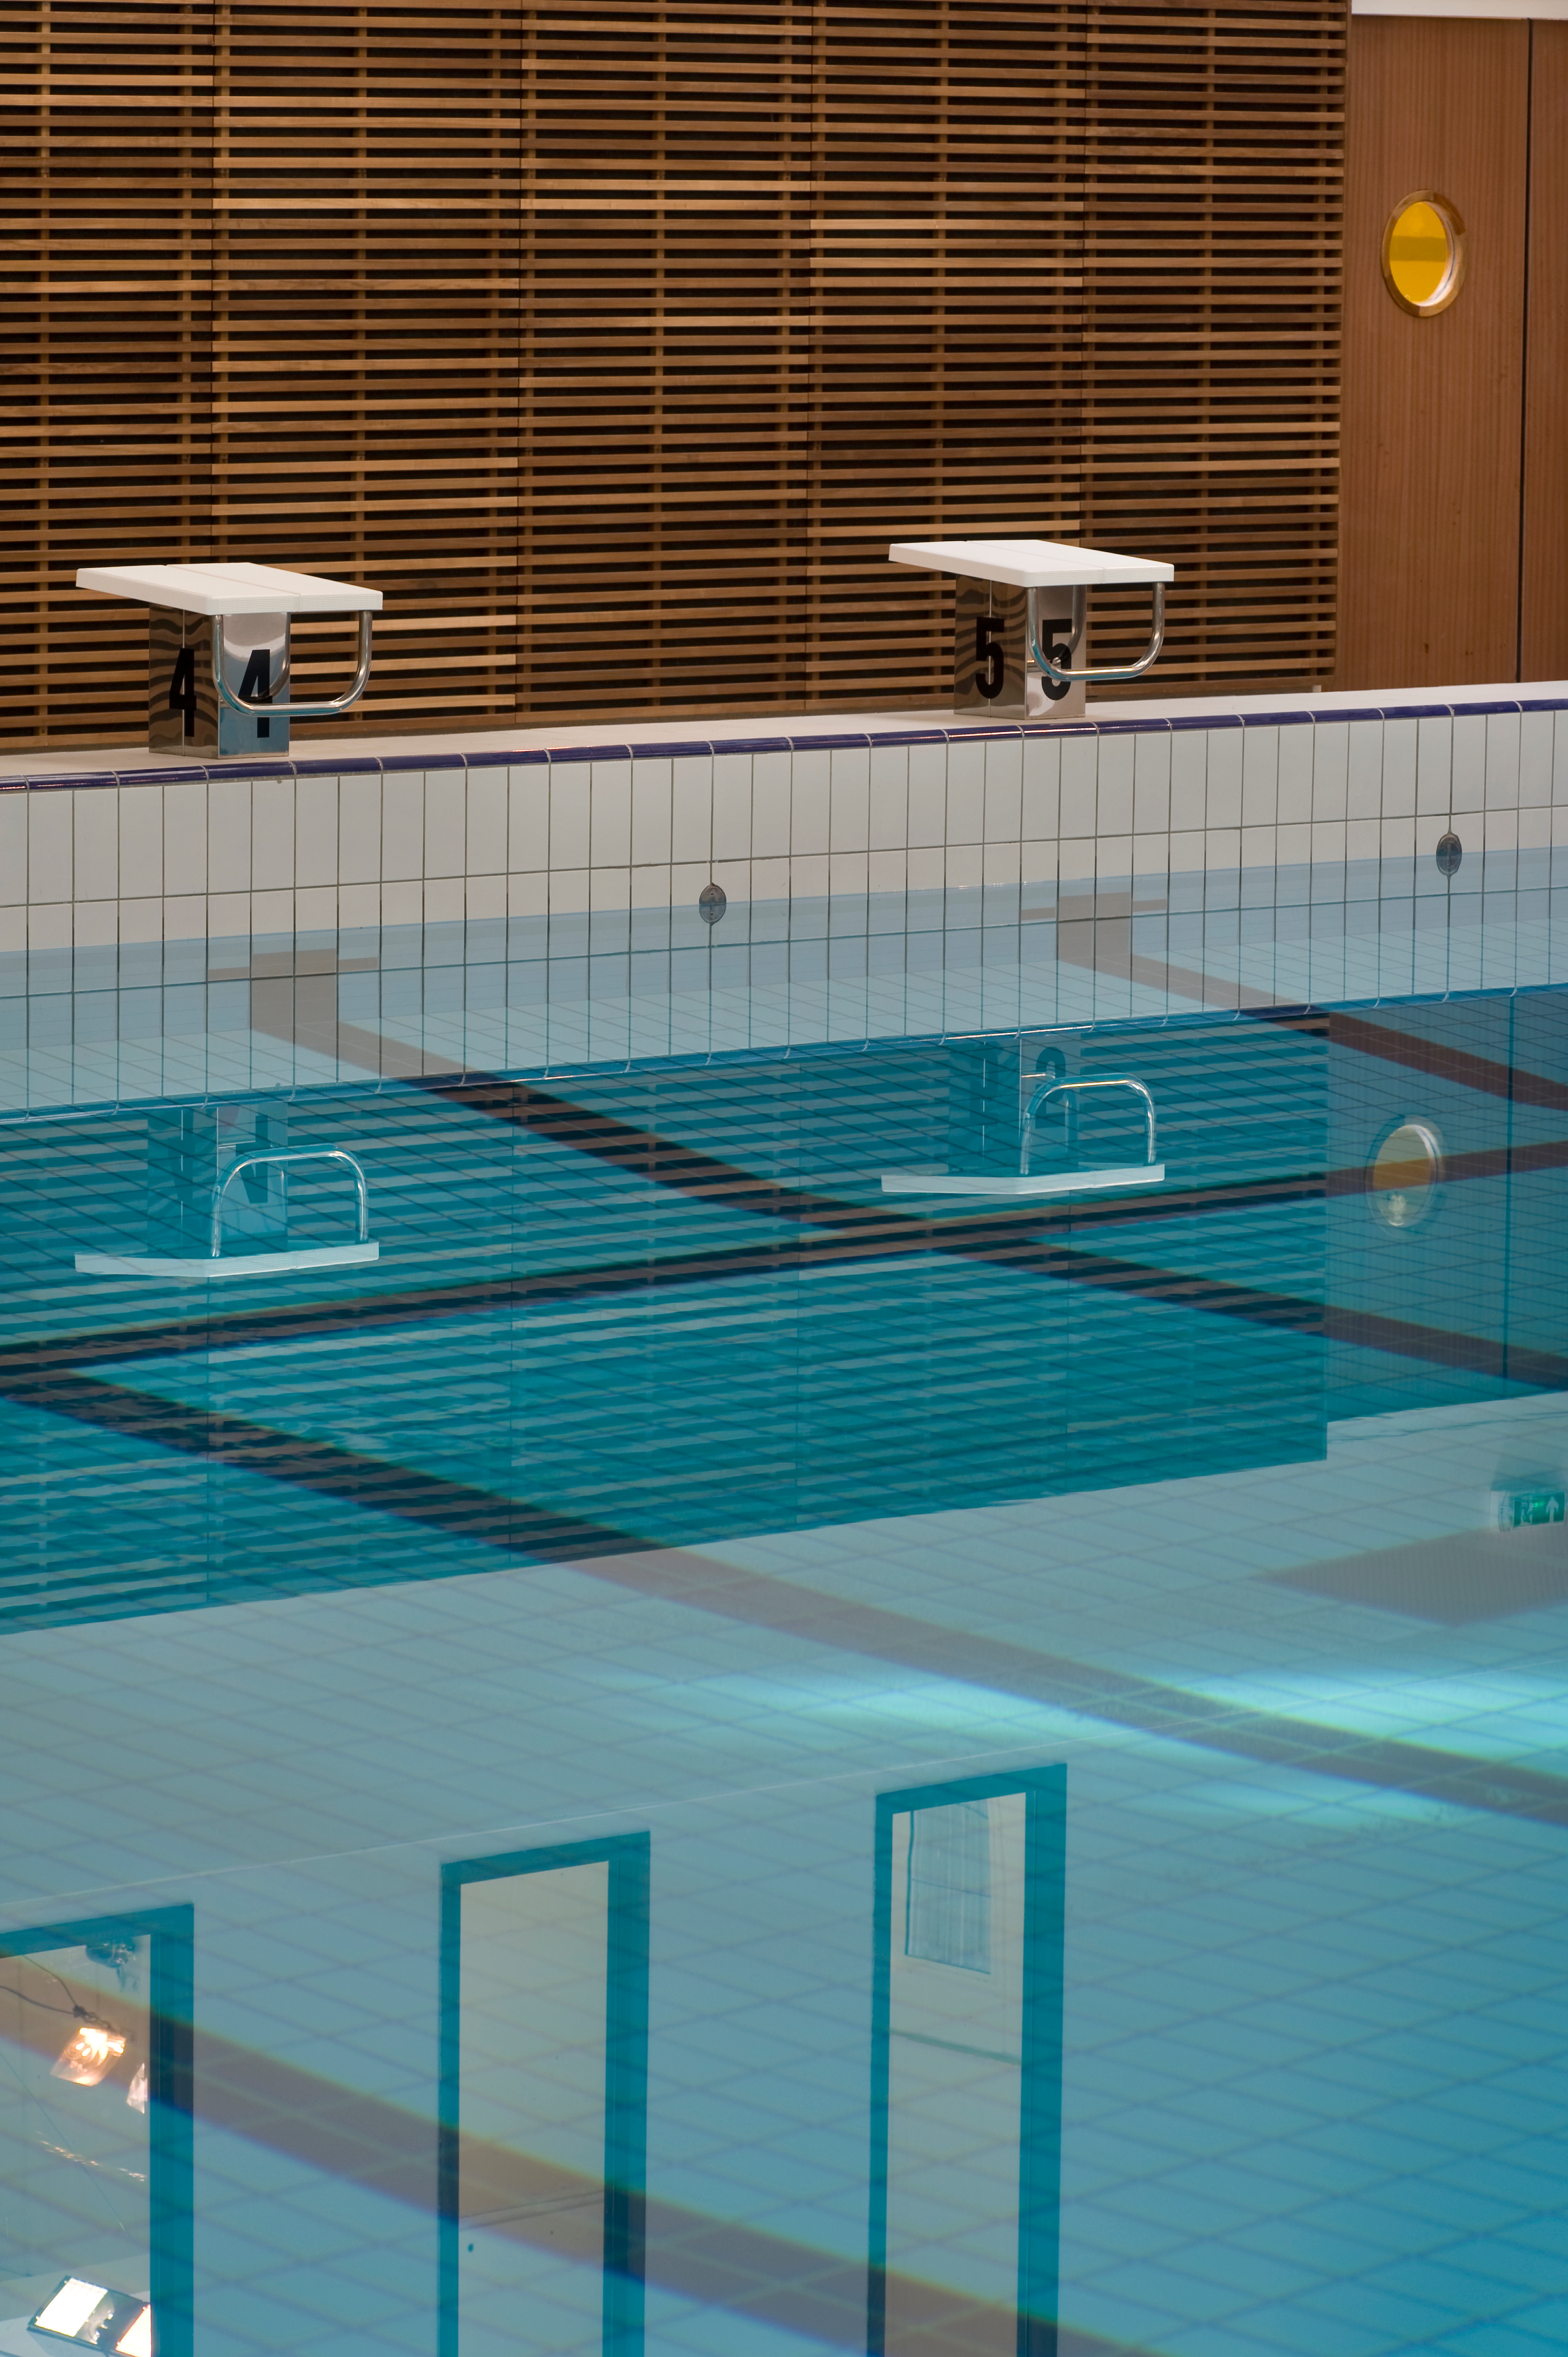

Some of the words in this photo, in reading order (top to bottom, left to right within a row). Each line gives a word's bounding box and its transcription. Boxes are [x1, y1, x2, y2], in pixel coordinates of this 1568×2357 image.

[169, 648, 197, 737] 4
[238, 649, 273, 738] 4
[975, 616, 1005, 699] 5
[1041, 618, 1072, 701] 5
